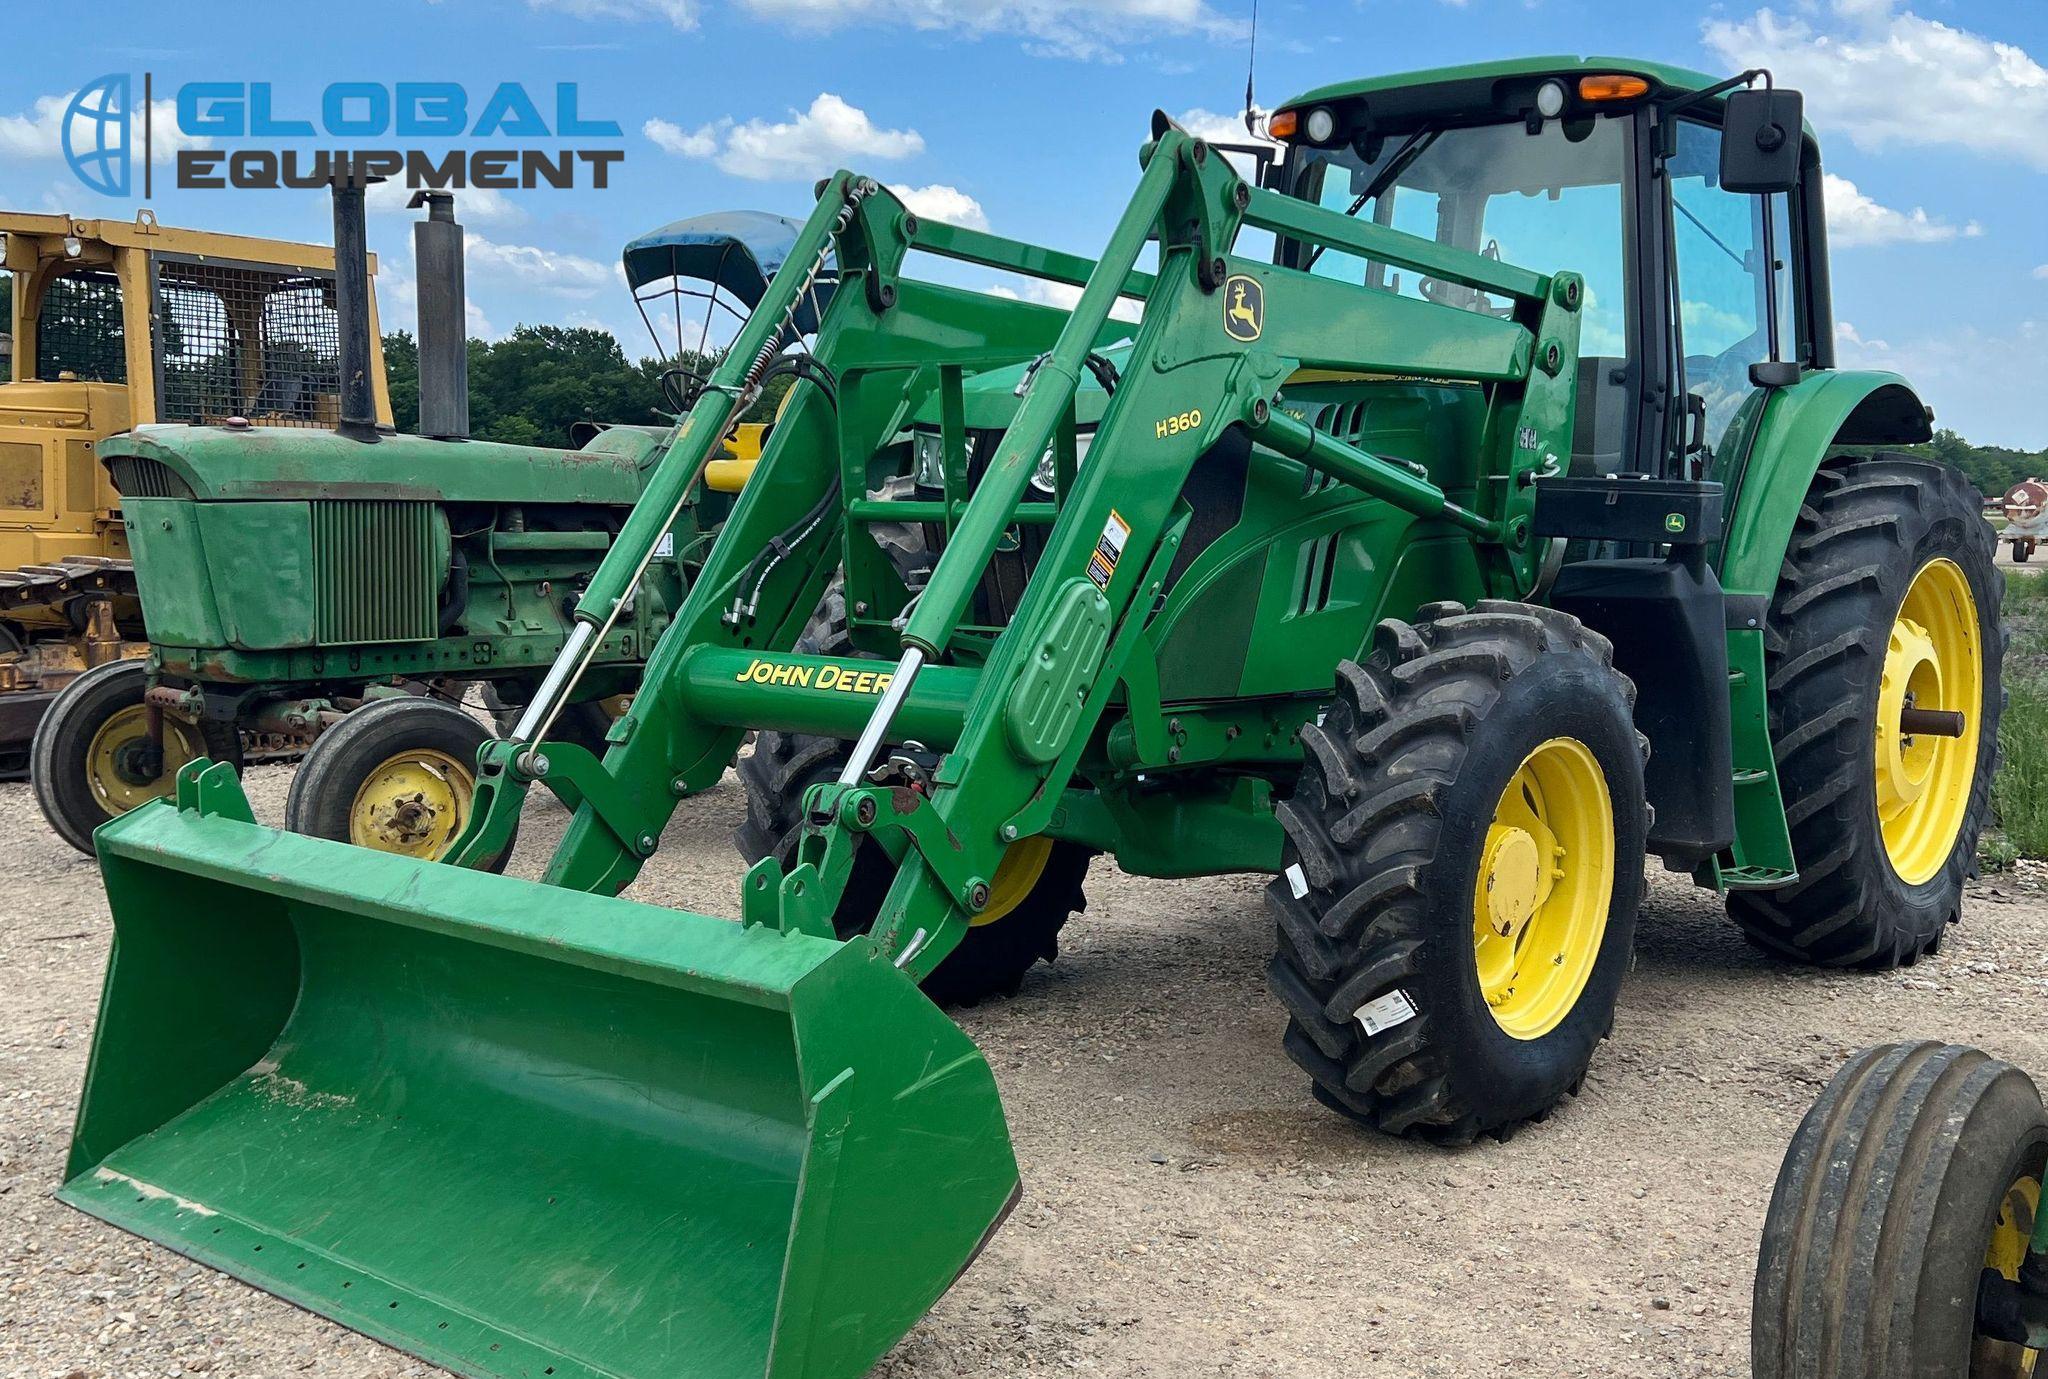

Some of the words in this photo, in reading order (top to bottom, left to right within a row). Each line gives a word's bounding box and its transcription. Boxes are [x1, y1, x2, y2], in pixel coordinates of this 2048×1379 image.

[1155, 409, 1202, 439] H360
[736, 659, 815, 687] JOHN
[814, 665, 894, 694] DEER
